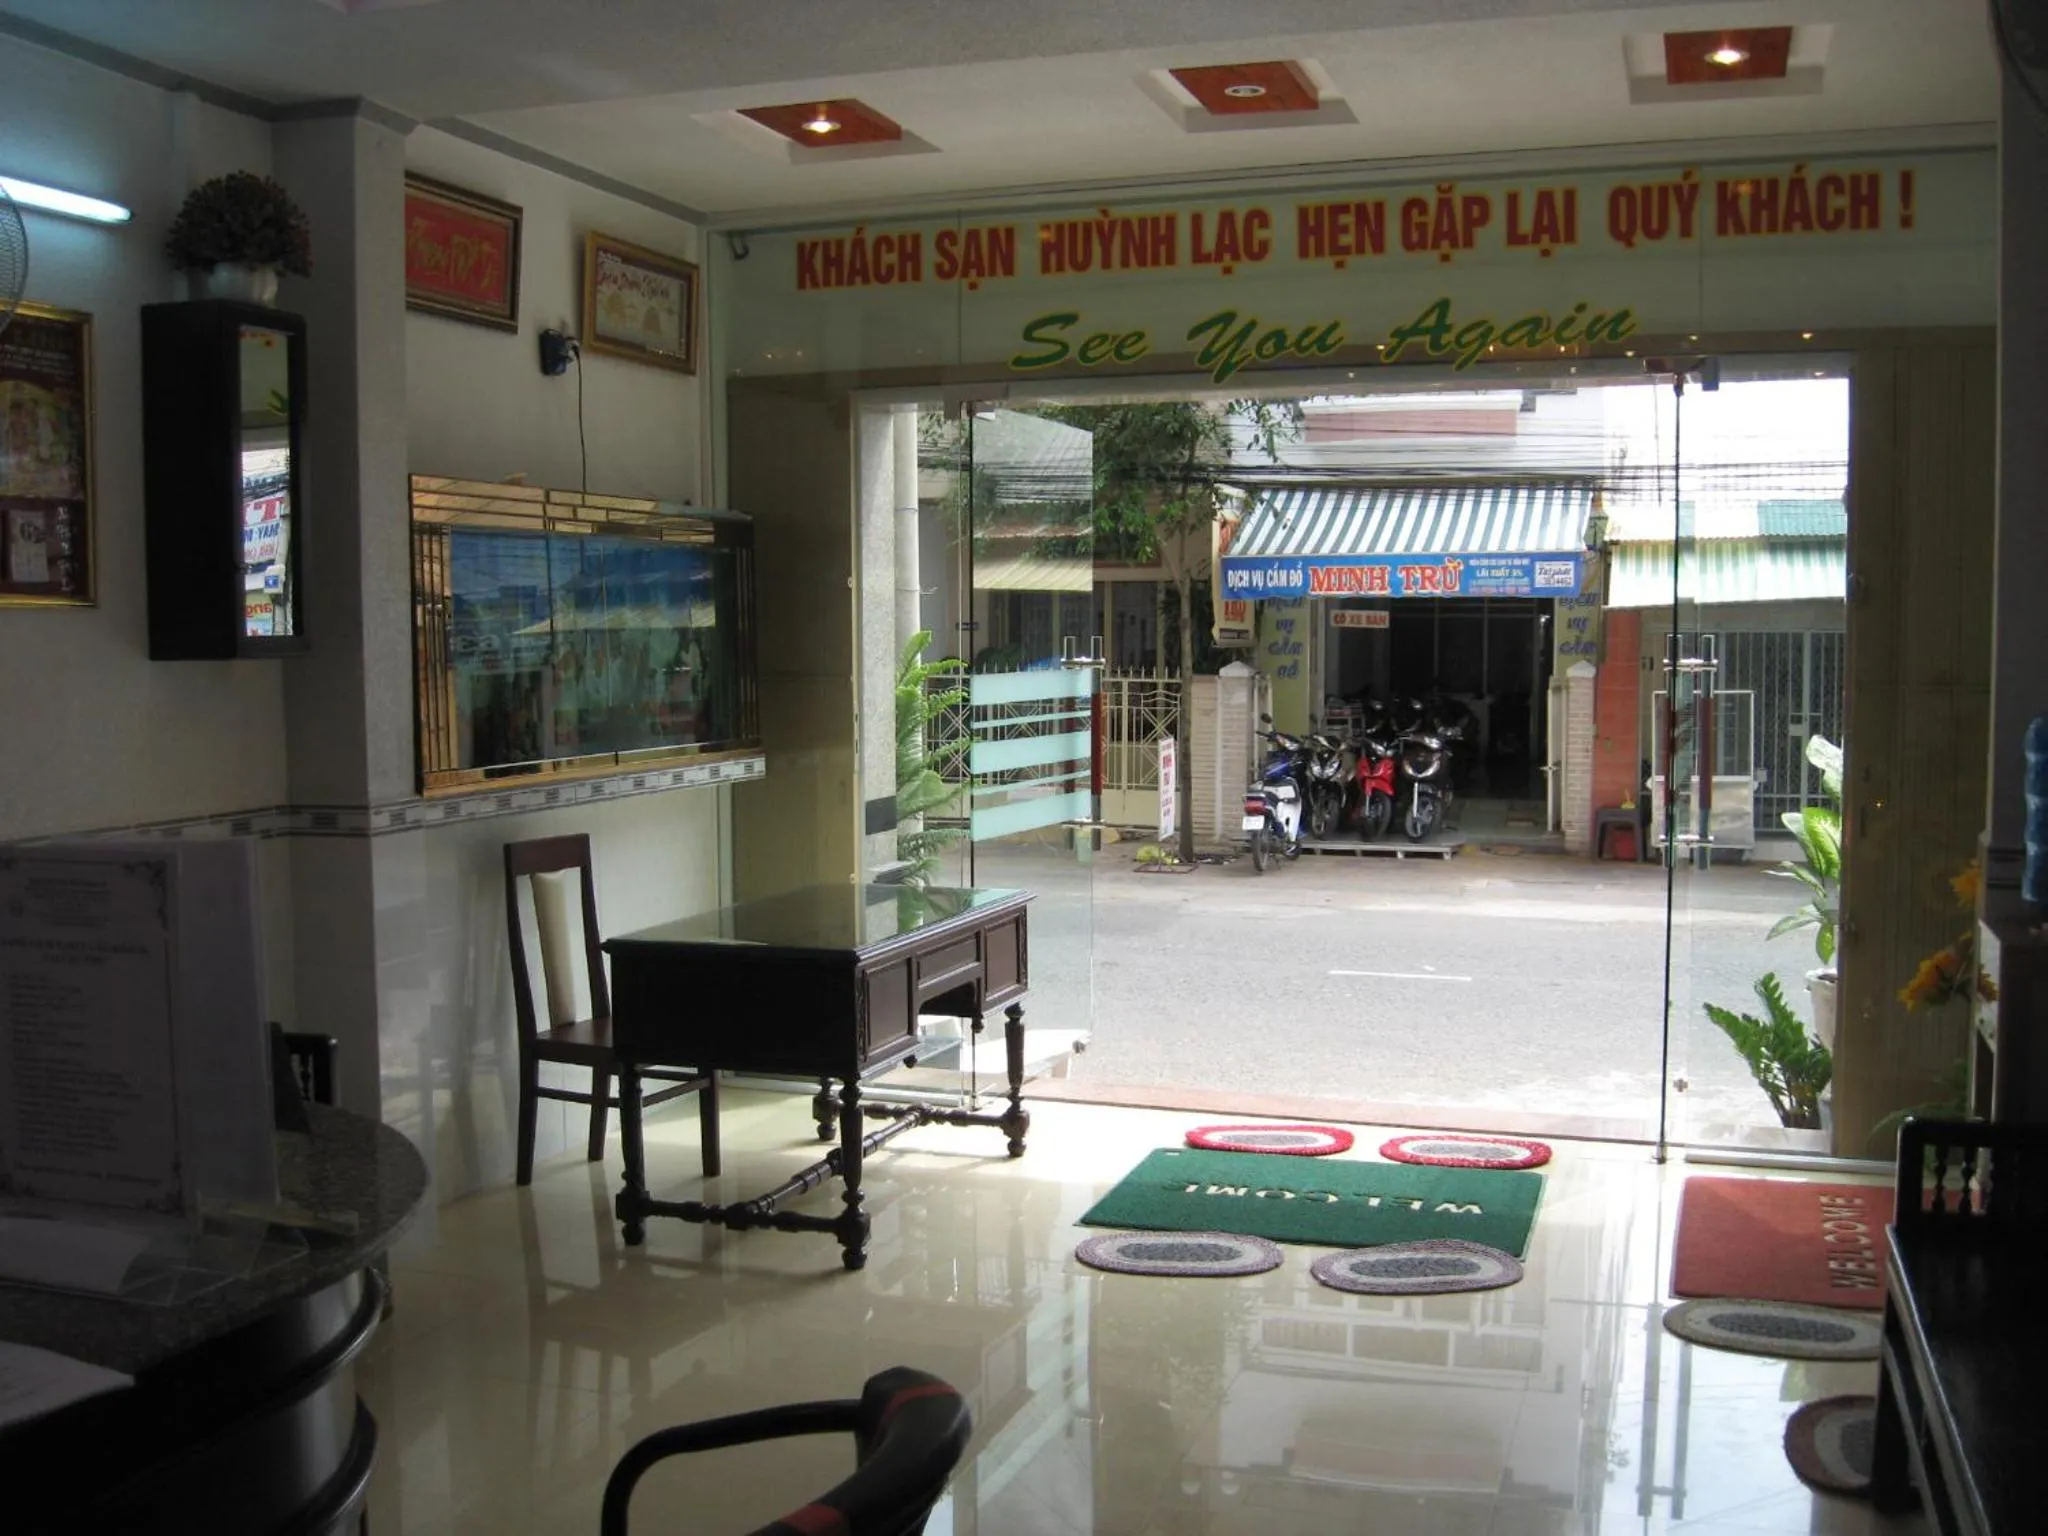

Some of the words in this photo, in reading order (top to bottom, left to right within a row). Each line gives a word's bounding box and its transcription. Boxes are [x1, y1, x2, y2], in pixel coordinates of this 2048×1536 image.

[796, 226, 924, 291] KHÁCH
[933, 227, 1018, 292] SẠN
[1038, 209, 1179, 276] HUỲNH
[1190, 209, 1272, 277] LẠC
[1297, 202, 1388, 270] HẸN
[1400, 184, 1494, 263] GẶP
[1506, 188, 1579, 258] LẠI
[1608, 170, 1701, 248] QUÝ
[1715, 164, 1882, 237] KHÁCH
[1007, 310, 1154, 371] See
[1184, 308, 1348, 382] You
[1377, 297, 1643, 373] Again
[1227, 569, 1250, 592] DỊCH
[1251, 569, 1264, 591] VỤ
[1309, 566, 1390, 594] MINH
[1819, 1194, 1889, 1290] WELCOME
